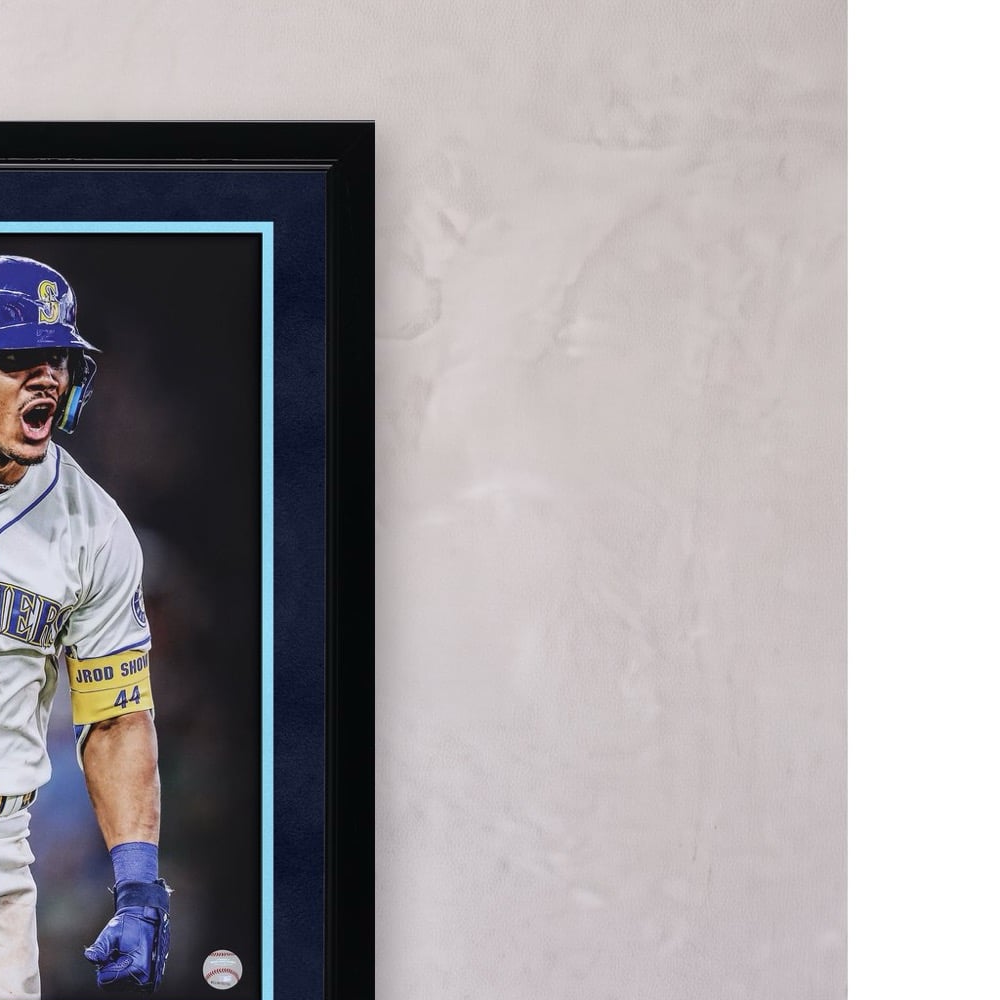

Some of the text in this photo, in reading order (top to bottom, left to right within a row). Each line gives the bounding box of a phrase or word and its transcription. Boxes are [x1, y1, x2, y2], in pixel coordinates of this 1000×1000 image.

[38, 280, 60, 324] S
[76, 666, 114, 683] JROD
[114, 685, 140, 709] 44
